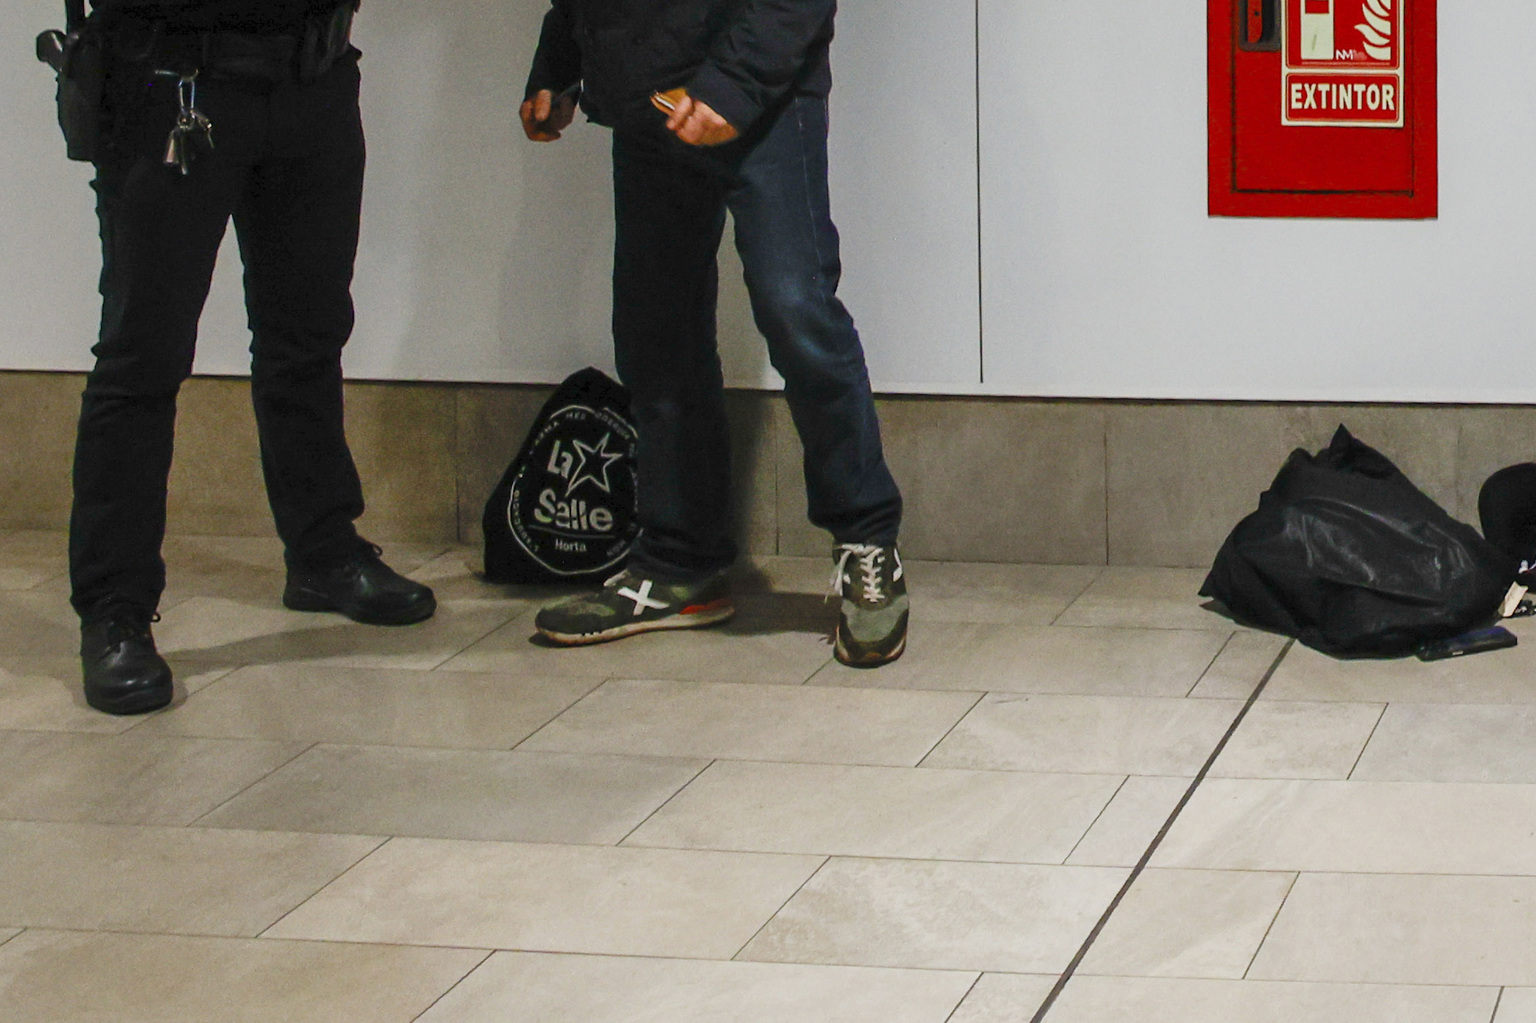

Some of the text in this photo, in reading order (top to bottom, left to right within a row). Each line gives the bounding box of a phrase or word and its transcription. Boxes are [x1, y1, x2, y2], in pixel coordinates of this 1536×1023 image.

[1290, 83, 1396, 111] EXTINTOR
[533, 487, 614, 532] Salle
[554, 538, 588, 553] Horta
